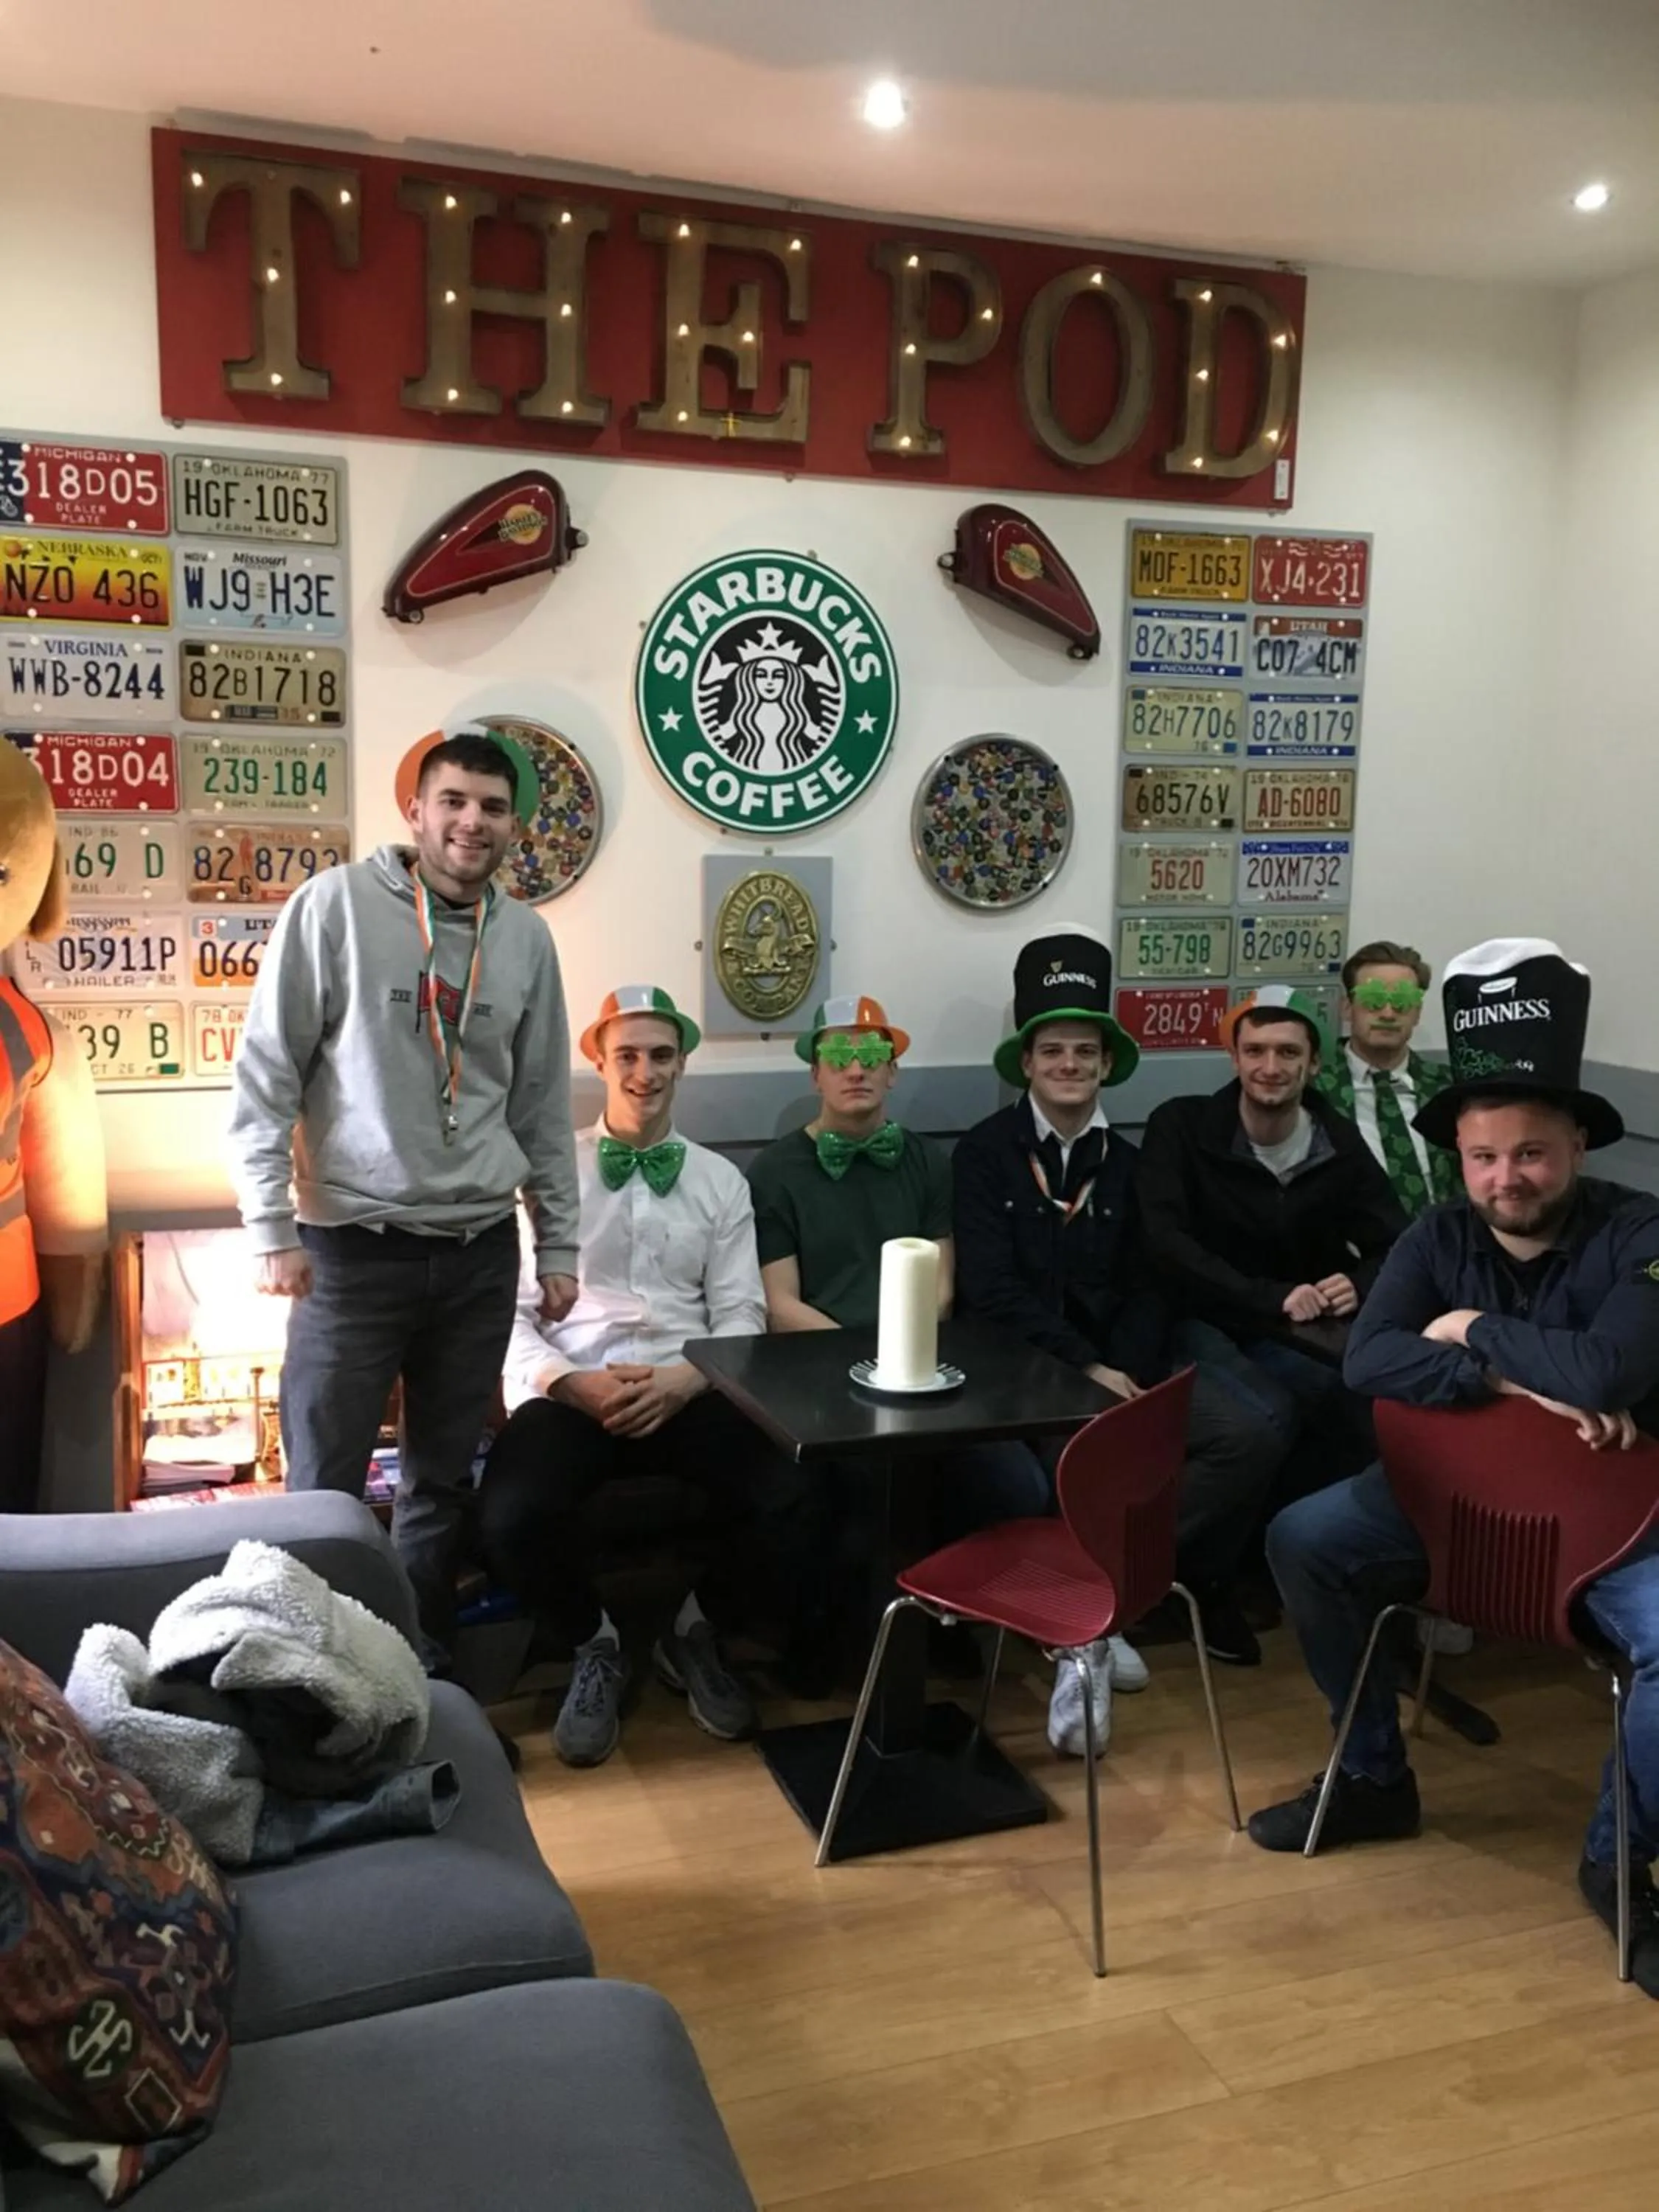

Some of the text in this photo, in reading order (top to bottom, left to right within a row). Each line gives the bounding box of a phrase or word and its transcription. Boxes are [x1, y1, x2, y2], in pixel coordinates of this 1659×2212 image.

[182, 150, 1298, 480] THE POD
[34, 447, 122, 462] MICHIGAN
[7, 459, 159, 506] 318D05
[211, 463, 300, 481] OKLAHOMA
[55, 502, 107, 514] DEALER
[184, 478, 328, 526] HGF-1063
[60, 514, 101, 524] PLATE
[38, 540, 128, 558] NEBRASKA
[232, 552, 288, 566] Missouri
[93, 568, 159, 609] 436
[653, 566, 883, 684] STARBUCKS
[44, 639, 128, 658] VIRGINIA
[225, 649, 302, 664] INDIANA
[8, 656, 165, 700] WWB-8244
[189, 660, 337, 706] 82B1718
[47, 735, 132, 748] MICHIGAN
[221, 742, 309, 758] OKLAHOMA
[68, 787, 119, 799] DEALER
[203, 757, 328, 797] 239-184
[681, 751, 855, 819] COFFEE
[74, 799, 113, 808] PLATE
[1150, 858, 1205, 891] 5620
[724, 877, 810, 934] WHITBREAD
[1265, 890, 1320, 902] Alabama
[58, 935, 177, 973] 05911P
[199, 940, 268, 978] 066
[1143, 1002, 1203, 1035] 2849
[1453, 998, 1551, 1032] GUINNESS
